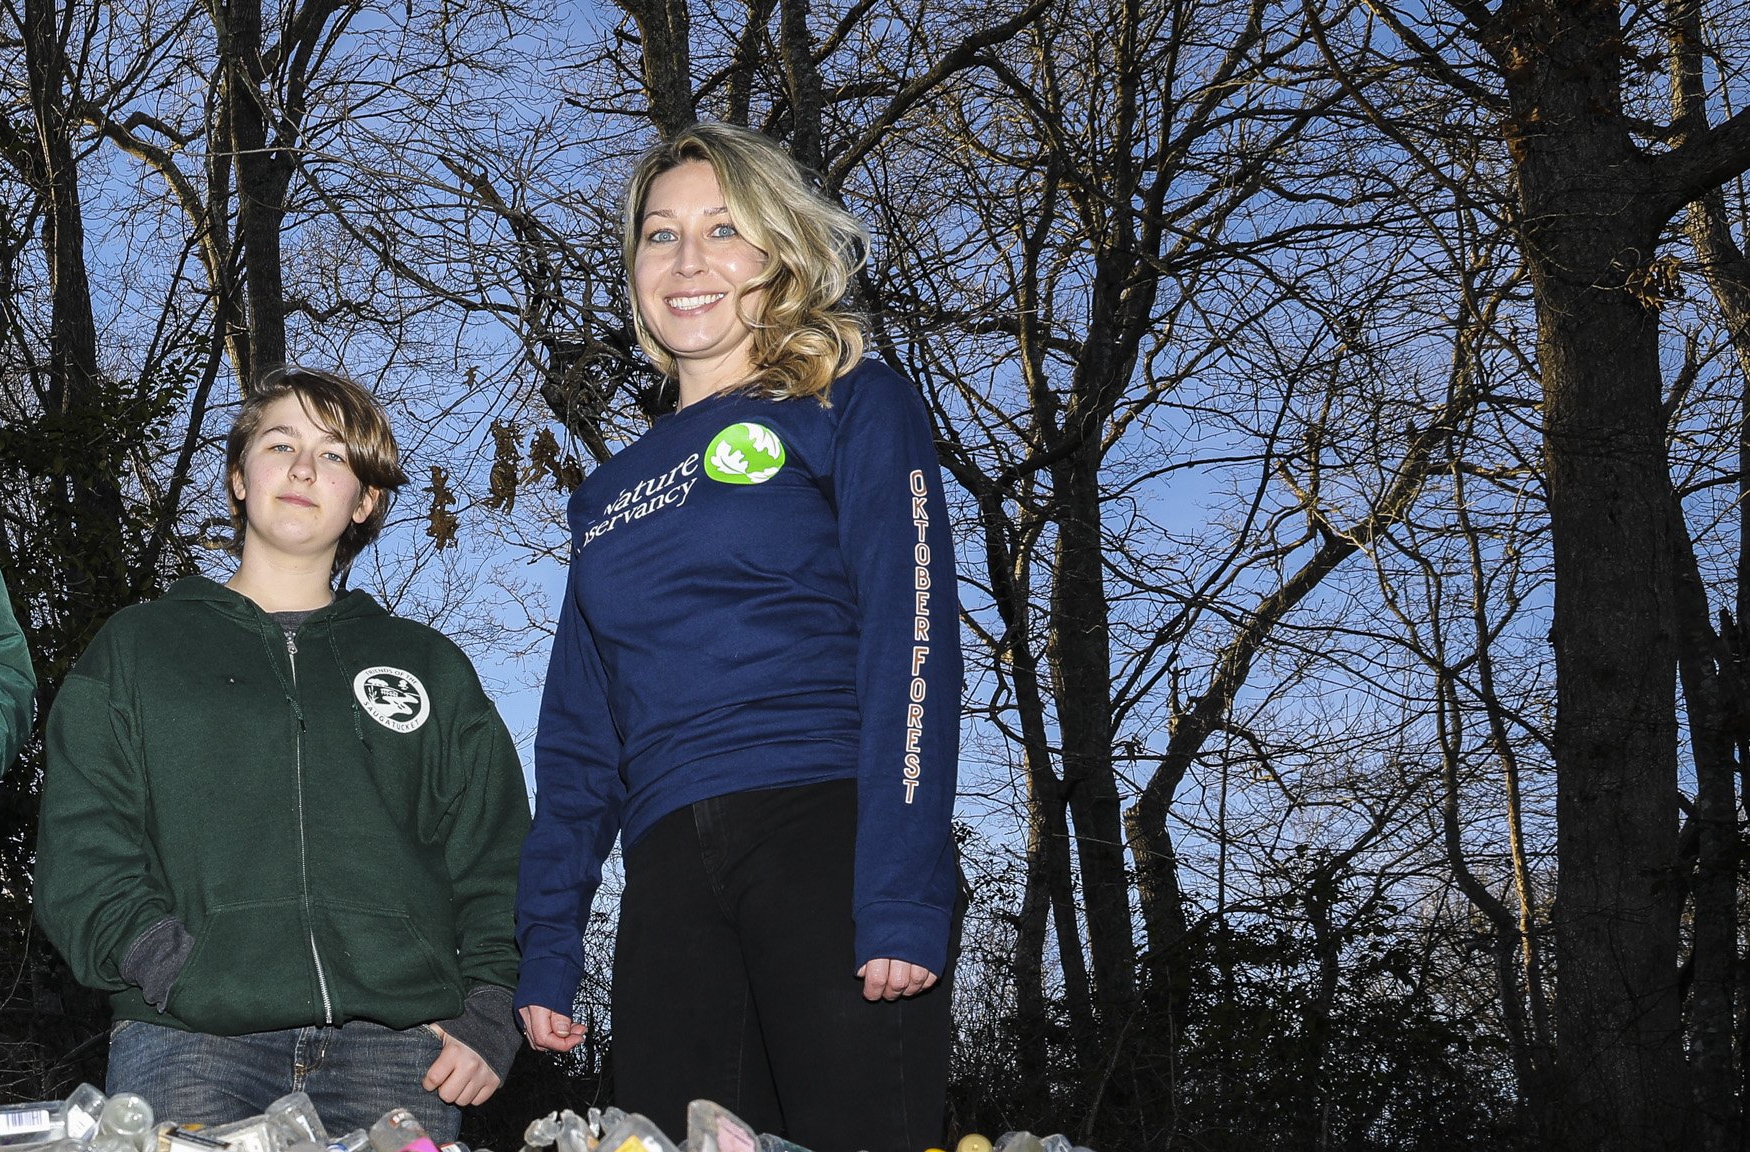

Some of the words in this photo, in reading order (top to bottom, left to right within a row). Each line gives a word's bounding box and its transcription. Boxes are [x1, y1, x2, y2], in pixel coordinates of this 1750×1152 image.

[582, 477, 698, 547] servancy
[602, 453, 700, 516] Nature
[909, 469, 931, 641] OKTOBER
[365, 668, 393, 676] FRIENDS
[405, 675, 418, 685] THE
[363, 701, 420, 732] SAUGATUCKET
[903, 645, 930, 804] FOREST
